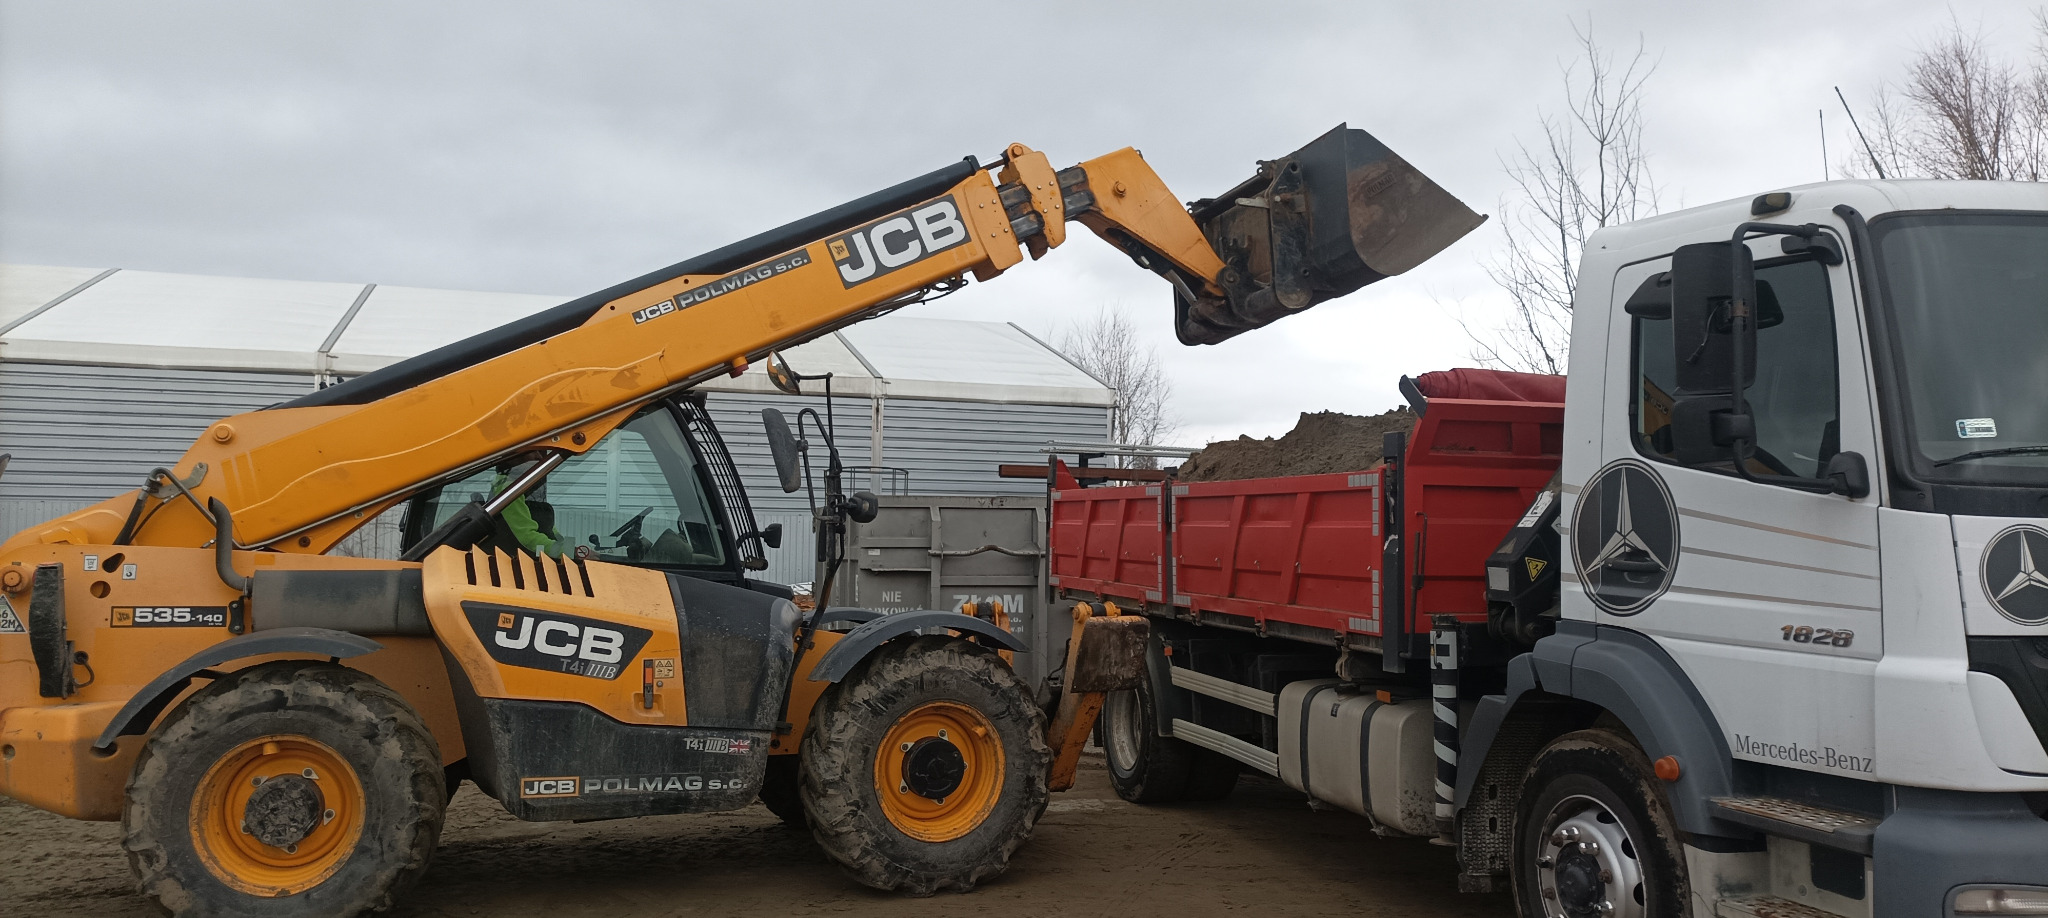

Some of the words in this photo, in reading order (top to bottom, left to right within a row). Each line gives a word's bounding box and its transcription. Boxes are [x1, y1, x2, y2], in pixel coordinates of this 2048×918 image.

[839, 201, 966, 283] JCB
[635, 301, 675, 323] JCB
[678, 265, 772, 307] POLMAG
[775, 256, 808, 273] s.c.
[882, 591, 902, 602] NIE
[0, 609, 9, 619] 6
[134, 607, 223, 623] 535-140
[0, 620, 16, 628] 2M
[495, 616, 625, 664] JCB
[1781, 625, 1855, 648] 1828
[560, 659, 585, 674] T4i
[683, 737, 704, 751] T4i
[1735, 733, 1873, 774] Mercedes-Benz
[525, 780, 575, 795] JCB
[584, 776, 703, 794] POLMAG
[708, 777, 749, 790] s.c.
